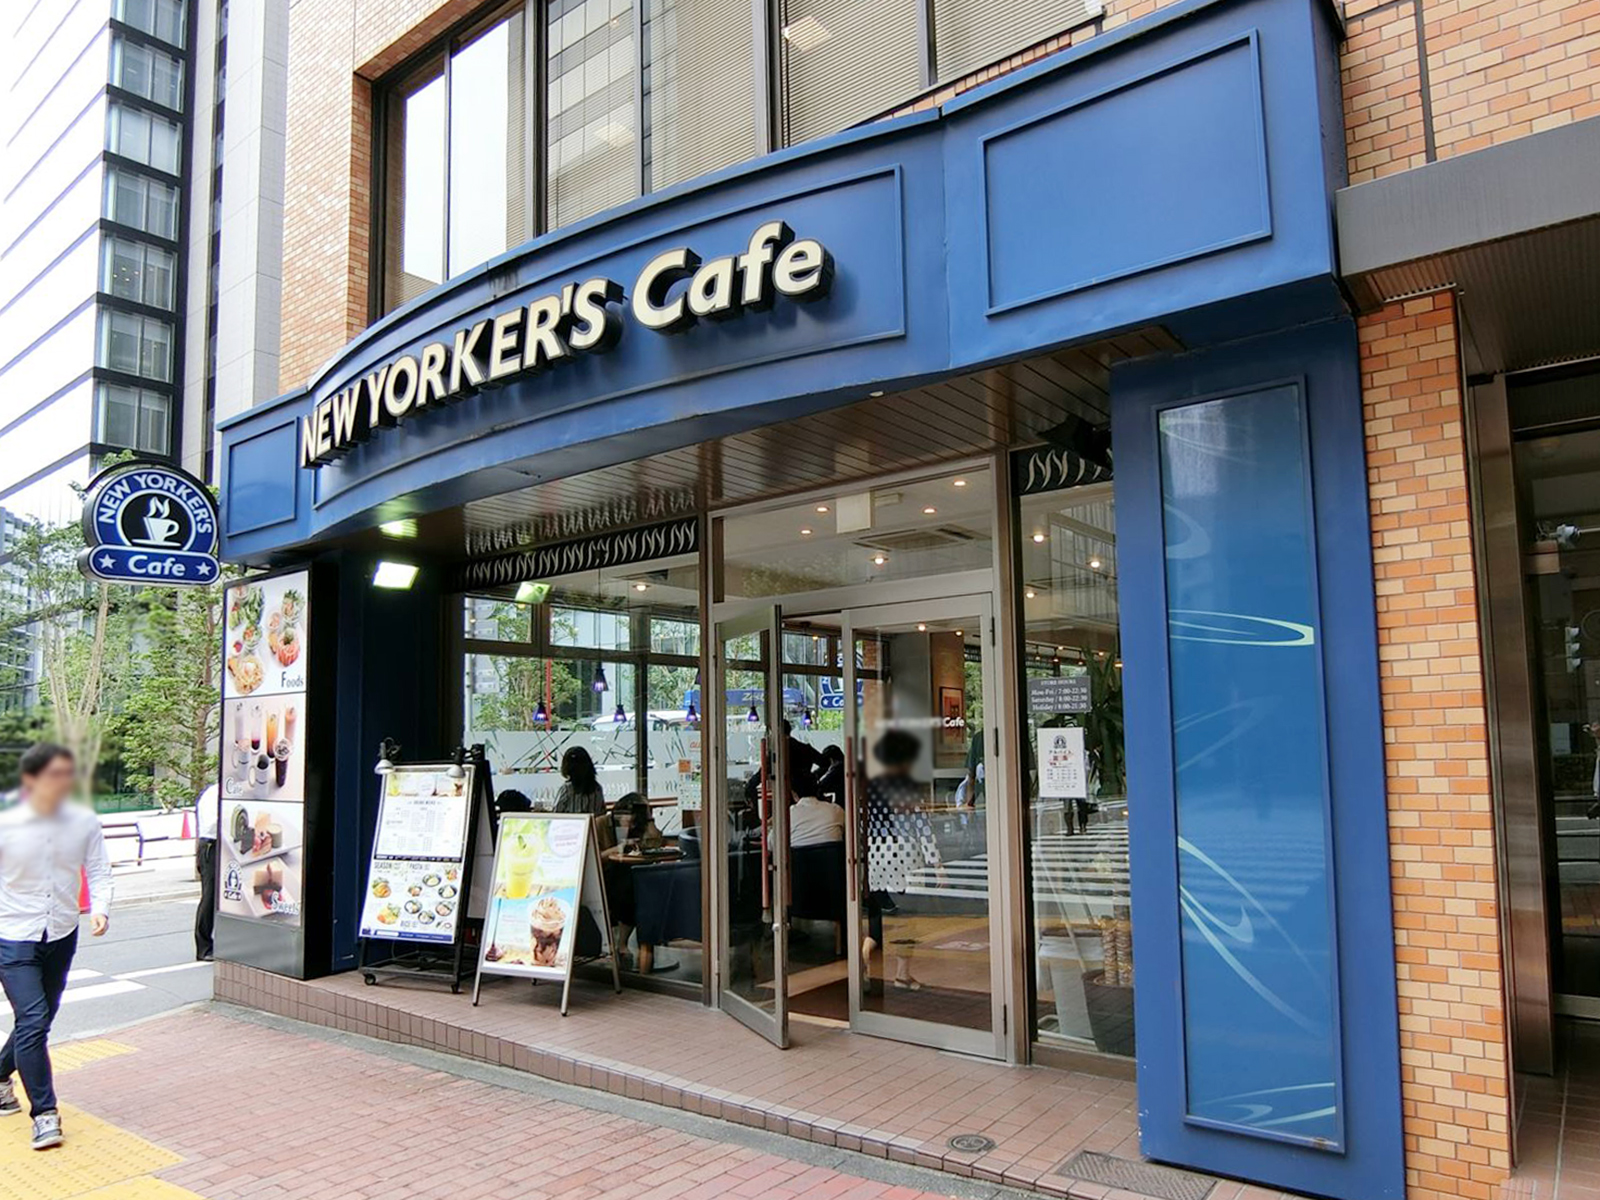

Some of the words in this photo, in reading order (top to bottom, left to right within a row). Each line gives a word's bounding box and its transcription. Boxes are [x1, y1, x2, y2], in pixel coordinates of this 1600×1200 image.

[301, 380, 362, 467] NEW
[366, 278, 609, 429] YORKER'S
[631, 220, 827, 330] Cafe
[98, 478, 132, 524] NEW
[133, 473, 212, 534] YORKER'S
[127, 554, 186, 577] Cafe
[281, 671, 304, 688] Foods
[943, 717, 965, 728] Cafe
[271, 890, 300, 916] Sweets
